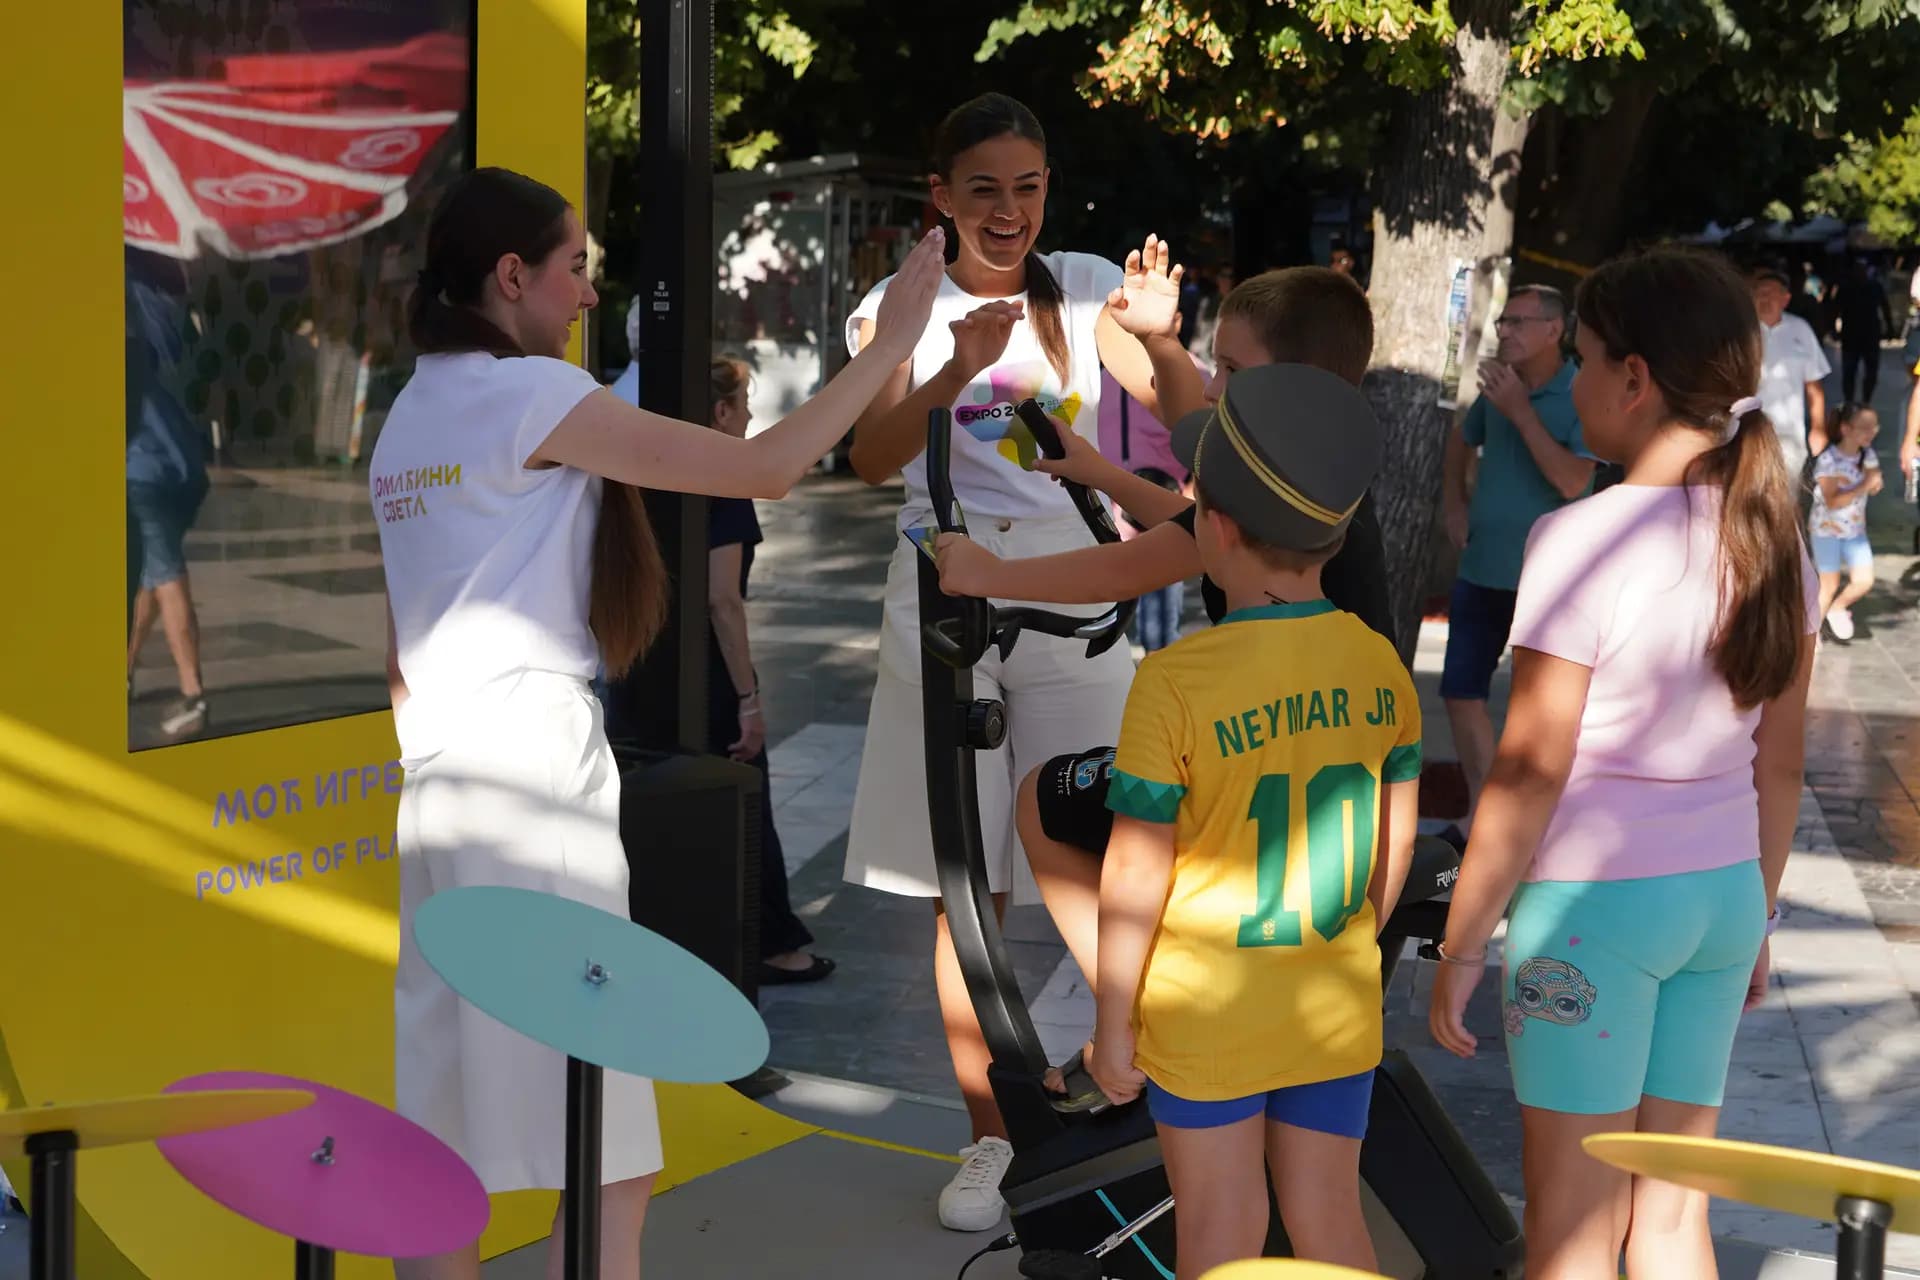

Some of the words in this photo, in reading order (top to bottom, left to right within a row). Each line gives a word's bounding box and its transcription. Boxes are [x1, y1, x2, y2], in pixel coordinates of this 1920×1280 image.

[959, 406, 1001, 421] EXPO
[1213, 688, 1351, 758] NEYMAR
[1366, 688, 1396, 726] JR
[212, 778, 302, 828] МОЋ
[314, 760, 400, 808] ИГРЕ
[196, 853, 303, 900] POWER
[312, 842, 347, 874] OF
[1237, 762, 1376, 948] 10
